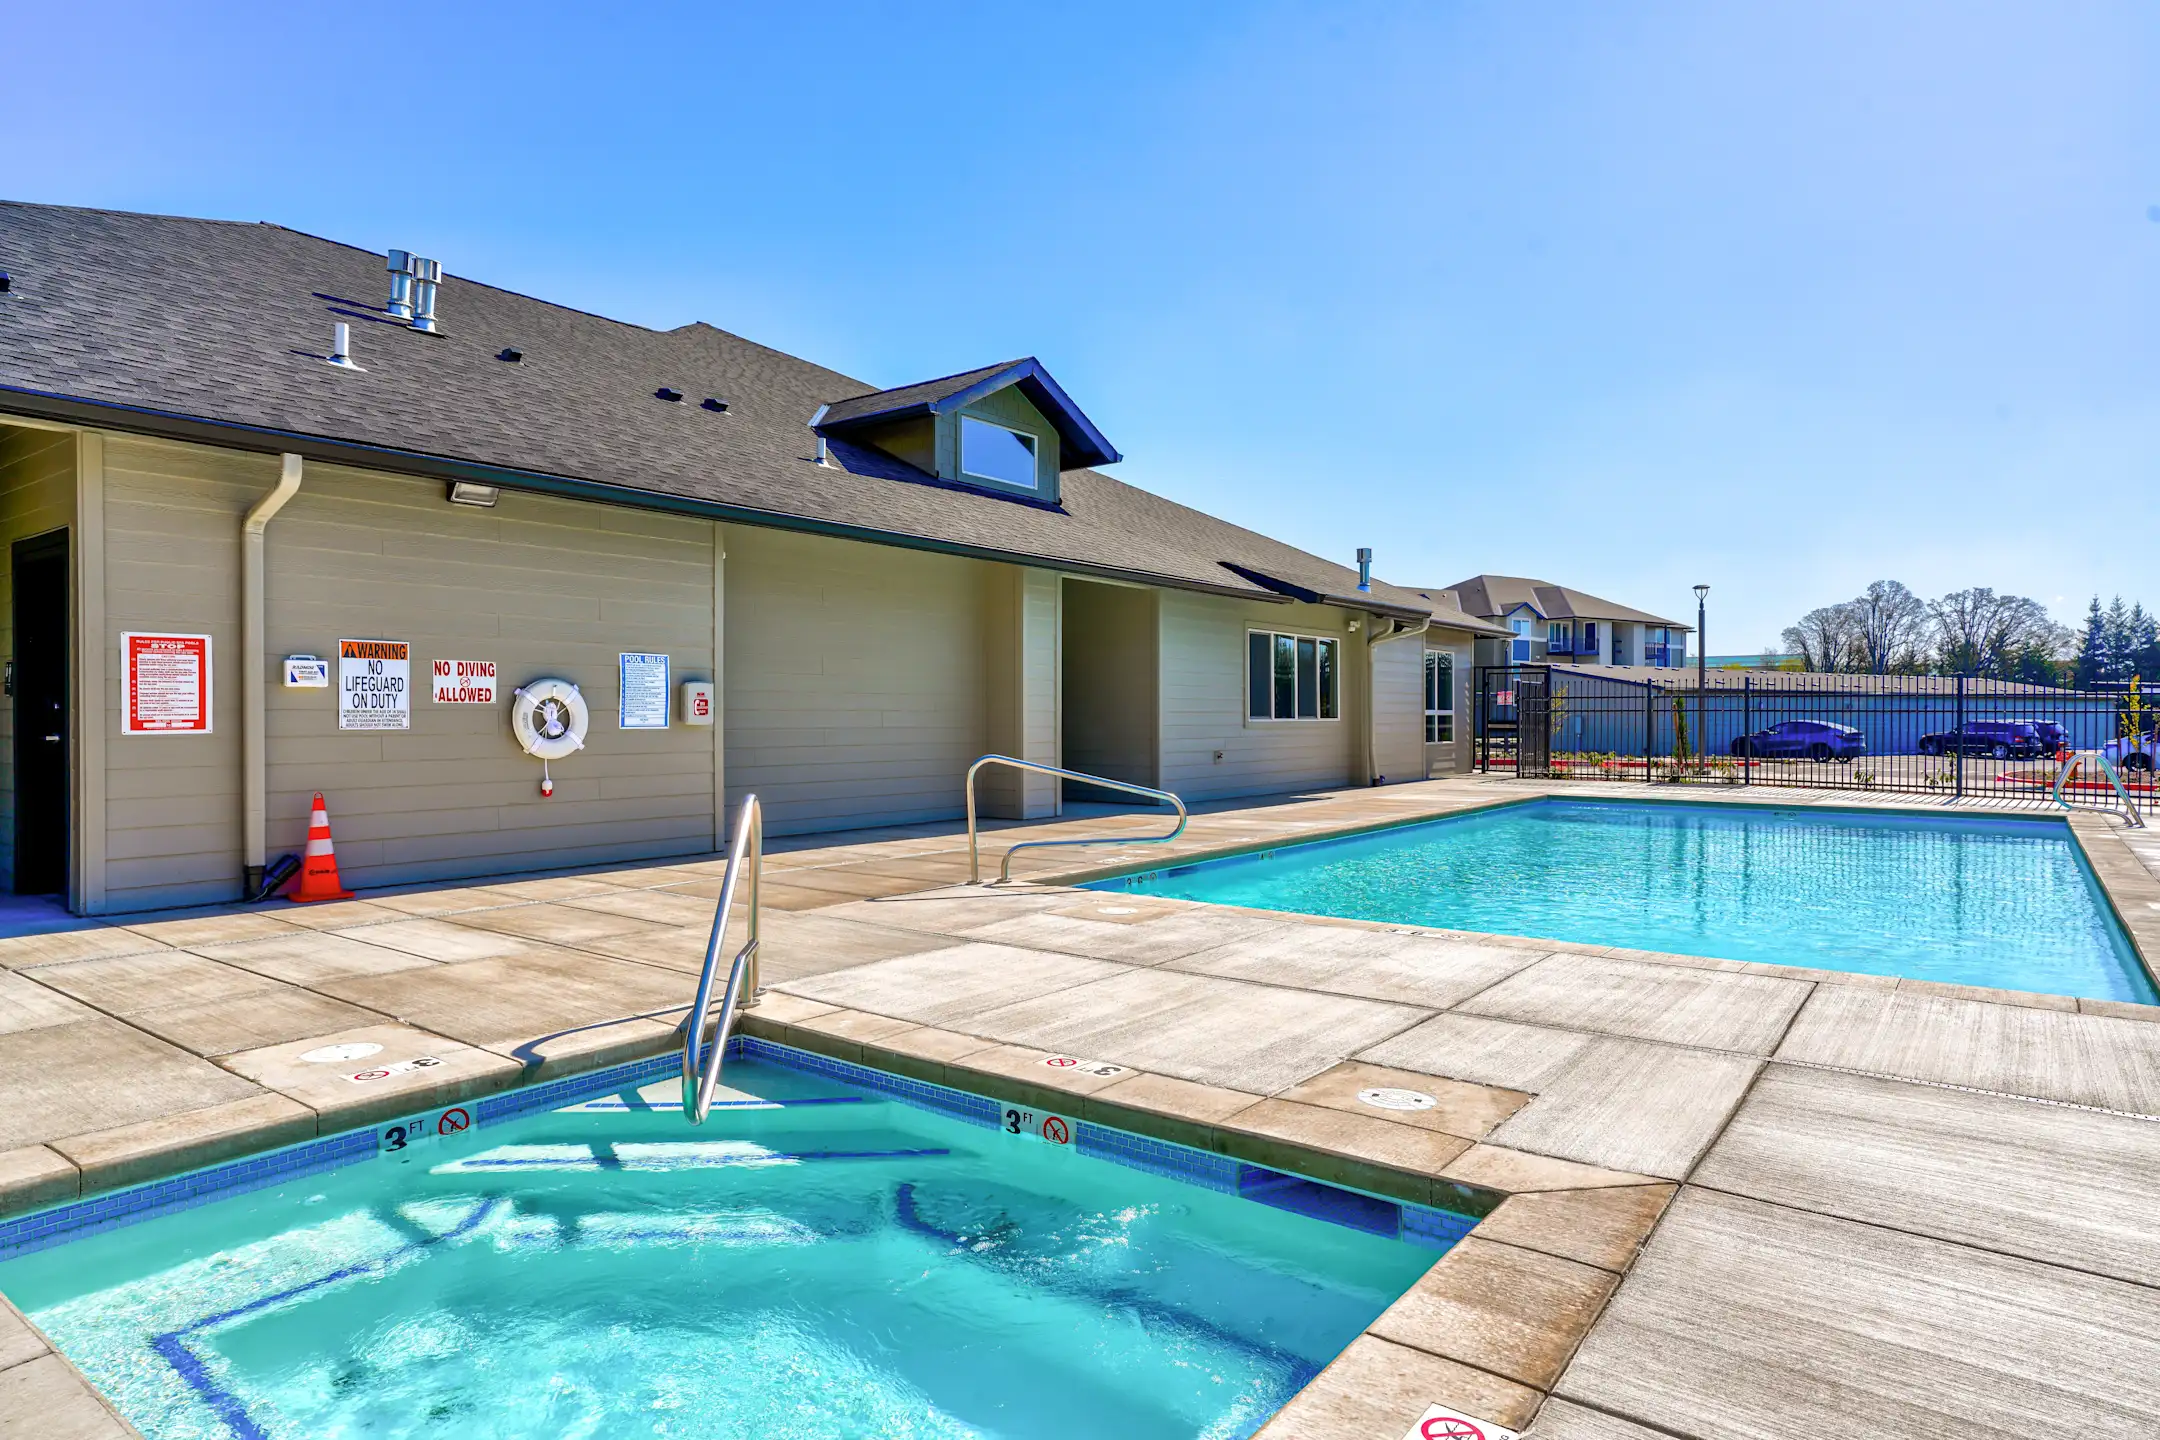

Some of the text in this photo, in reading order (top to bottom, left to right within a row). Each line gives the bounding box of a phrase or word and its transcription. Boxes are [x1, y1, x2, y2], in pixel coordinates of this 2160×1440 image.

[357, 643, 406, 659] WARNING
[368, 659, 383, 675] NO
[625, 655, 665, 664] POOL RULES
[434, 660, 495, 677] NO DIVING
[345, 676, 404, 692] LIFEGUARD
[352, 693, 398, 709] ON DUTY
[438, 687, 492, 702] ALLOWED
[412, 1058, 440, 1066] 3
[1093, 1066, 1121, 1075] 3
[1006, 1109, 1033, 1134] 3 FT
[385, 1119, 425, 1152] 3 FT
